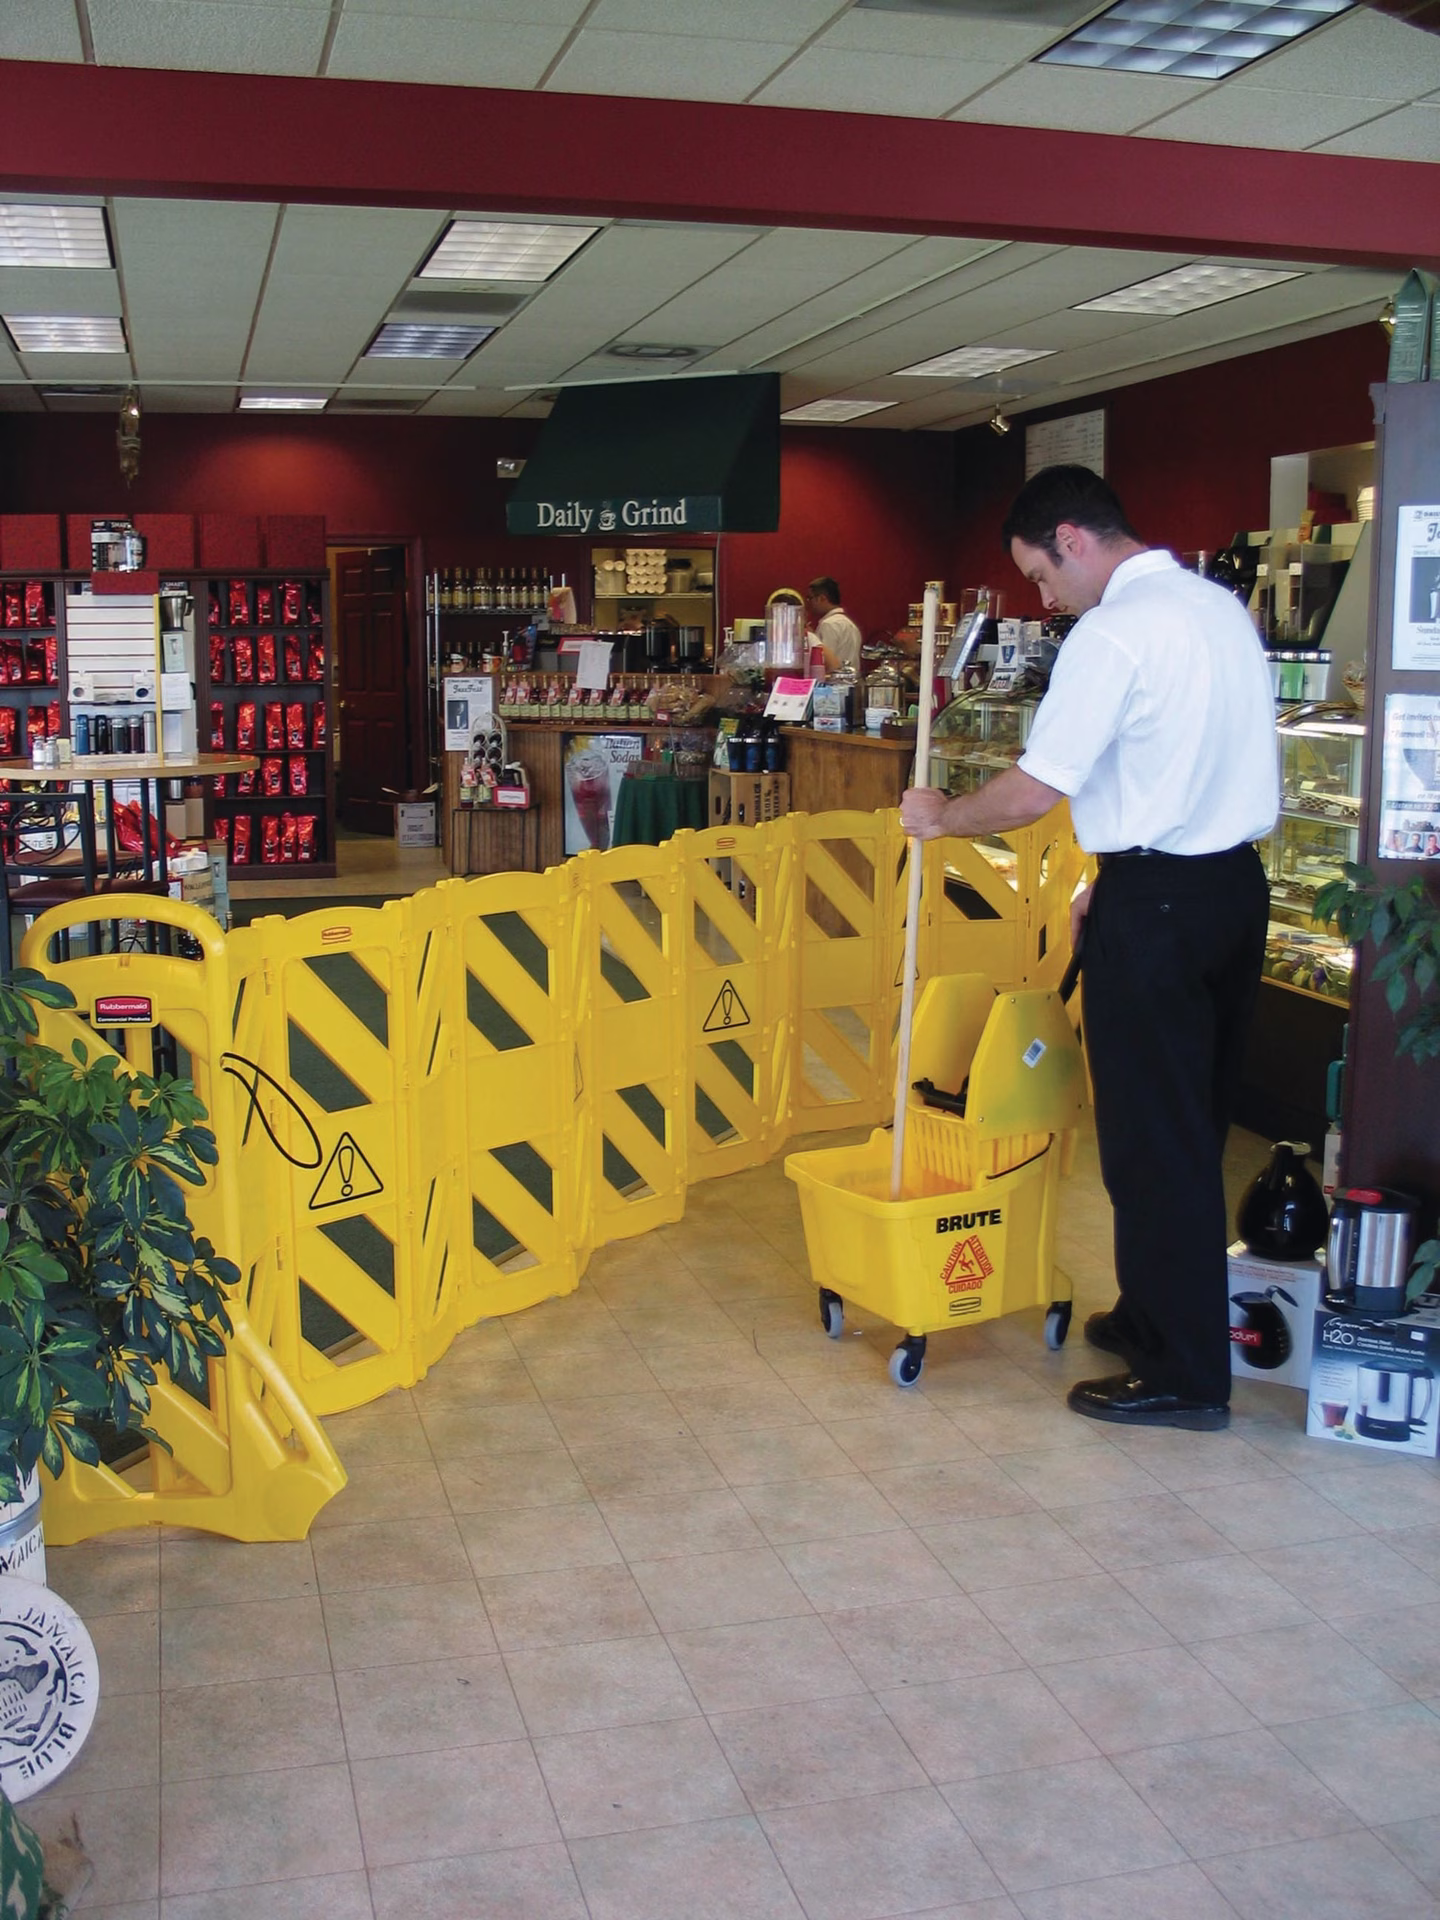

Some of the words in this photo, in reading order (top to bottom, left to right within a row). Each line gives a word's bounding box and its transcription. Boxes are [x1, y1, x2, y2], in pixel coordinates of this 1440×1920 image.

[537, 502, 594, 533] Daily
[621, 498, 687, 526] Grind
[610, 750, 640, 763] Sodas
[936, 1208, 1002, 1234] BRUTE
[940, 1241, 963, 1280] CAUTION
[969, 1234, 994, 1276] ATTENTION
[948, 1280, 982, 1294] CUIDADO
[1229, 1330, 1257, 1342] odum
[1323, 1329, 1354, 1345] H2O
[0, 1526, 44, 1575] MAICA
[18, 1607, 86, 1706] JAMAICA
[19, 1722, 77, 1780] BLUE
